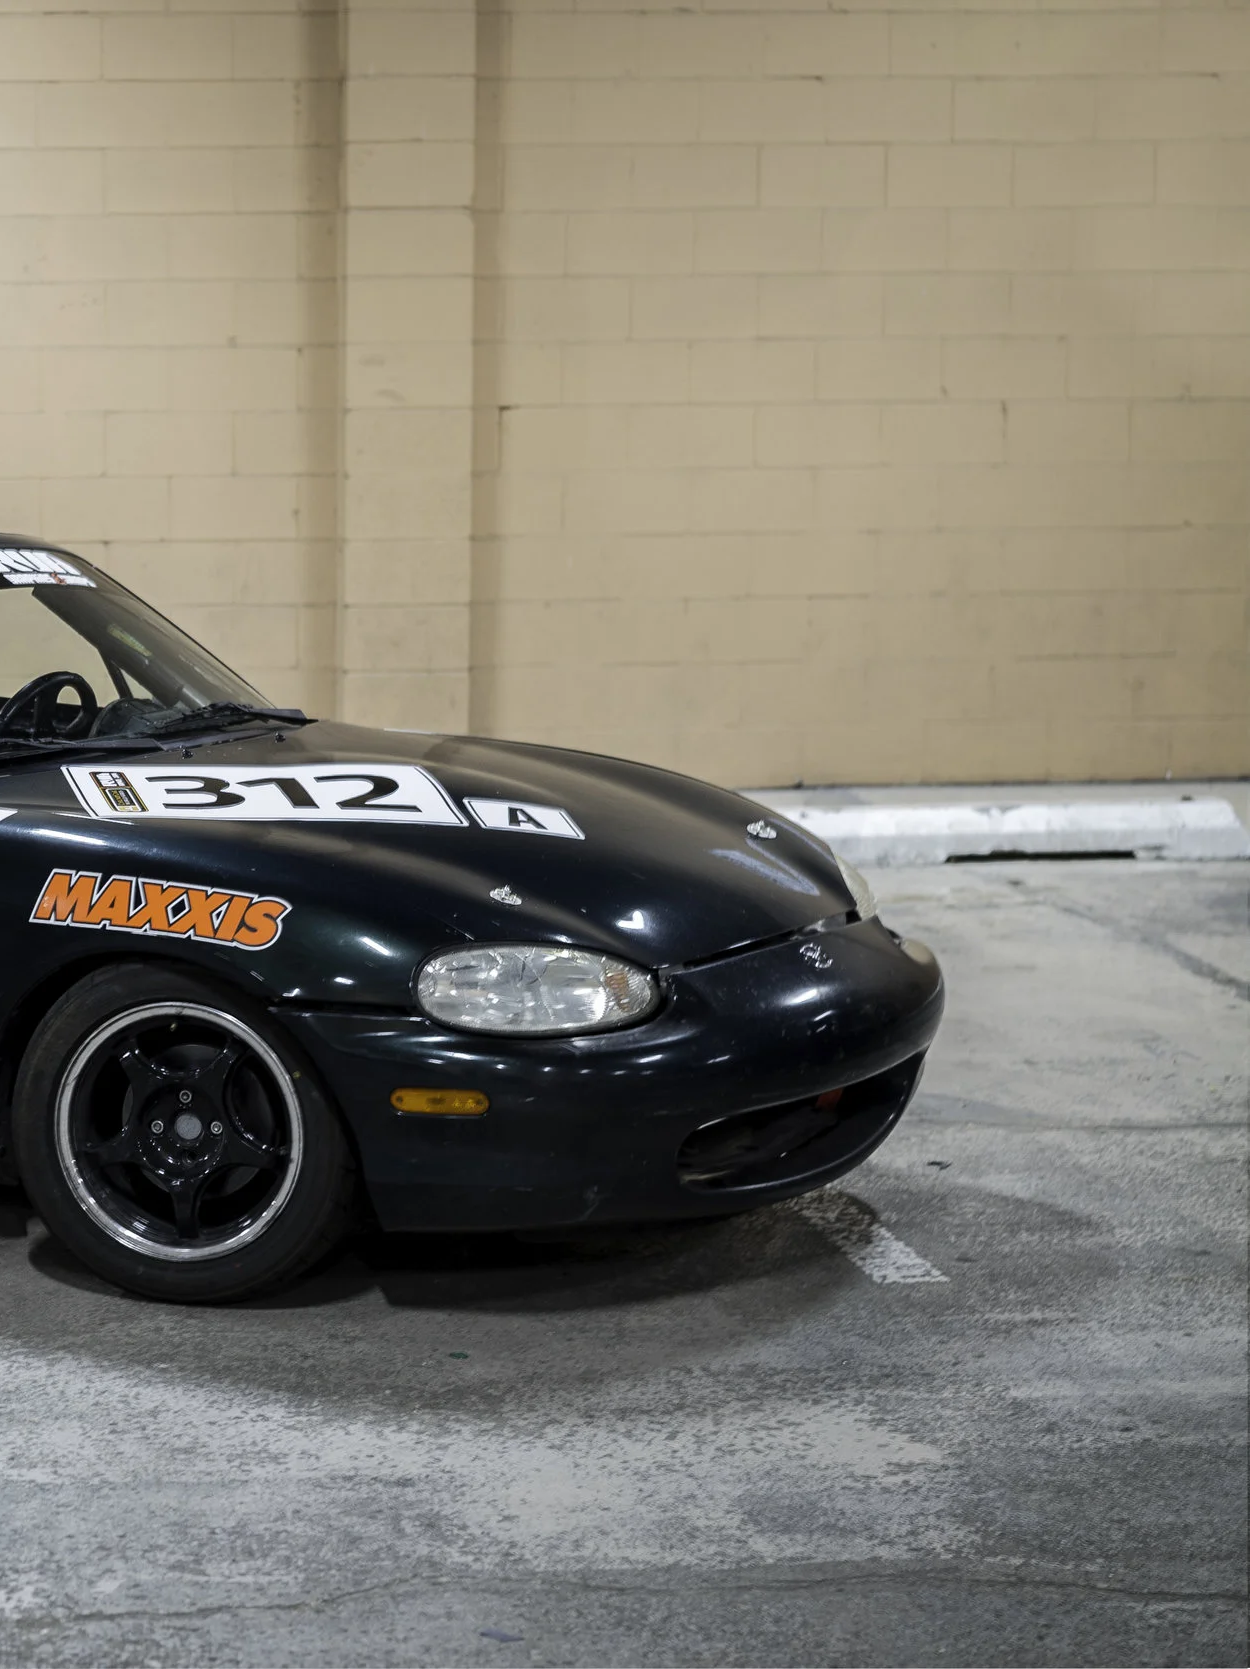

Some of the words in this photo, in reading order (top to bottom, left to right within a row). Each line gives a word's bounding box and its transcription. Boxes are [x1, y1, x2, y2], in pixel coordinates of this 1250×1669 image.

[145, 775, 423, 812] 312
[507, 807, 548, 831] A
[29, 868, 294, 951] MAXXIS
